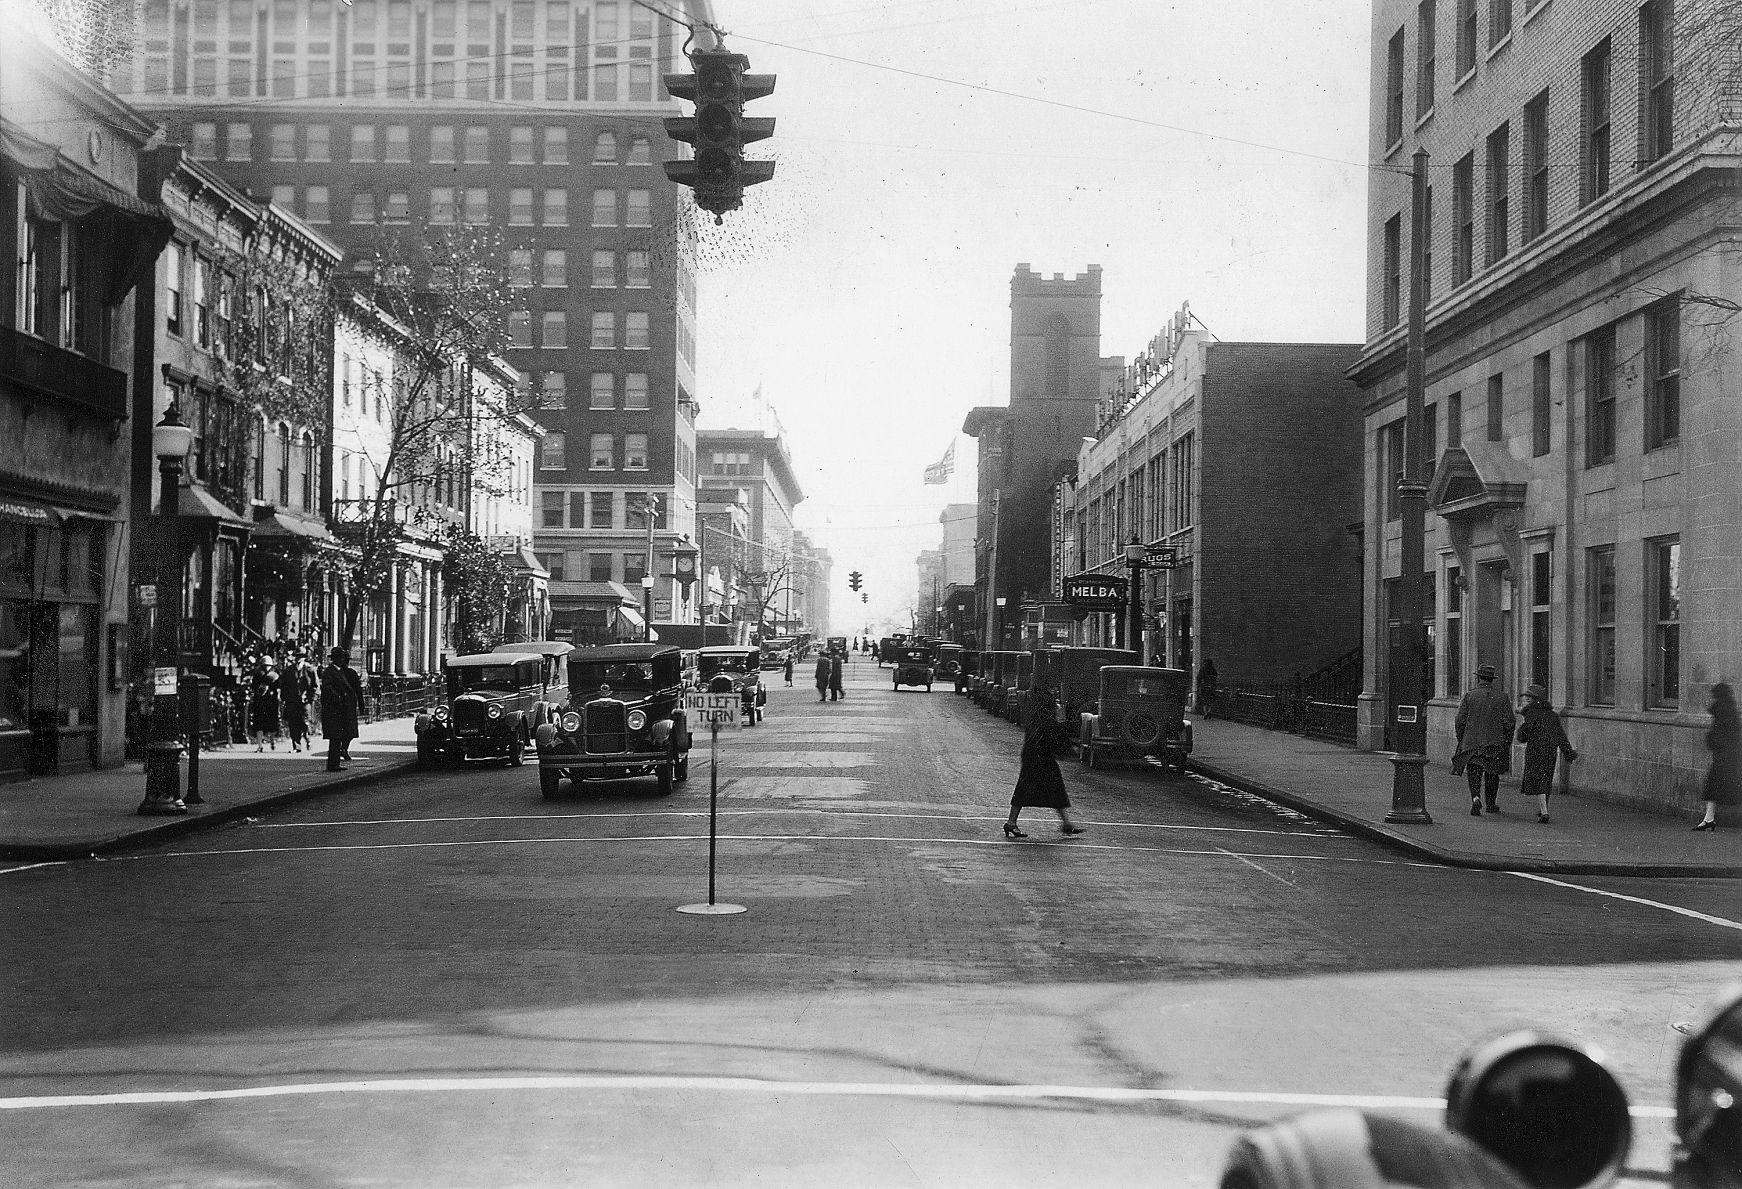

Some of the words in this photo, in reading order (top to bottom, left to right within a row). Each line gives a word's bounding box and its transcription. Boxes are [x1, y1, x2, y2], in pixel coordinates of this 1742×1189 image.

[1139, 553, 1171, 563] RUGS
[1071, 586, 1117, 597] MELBA
[688, 696, 704, 708] NO
[708, 696, 740, 708] LEFT
[697, 709, 734, 722] TURN
